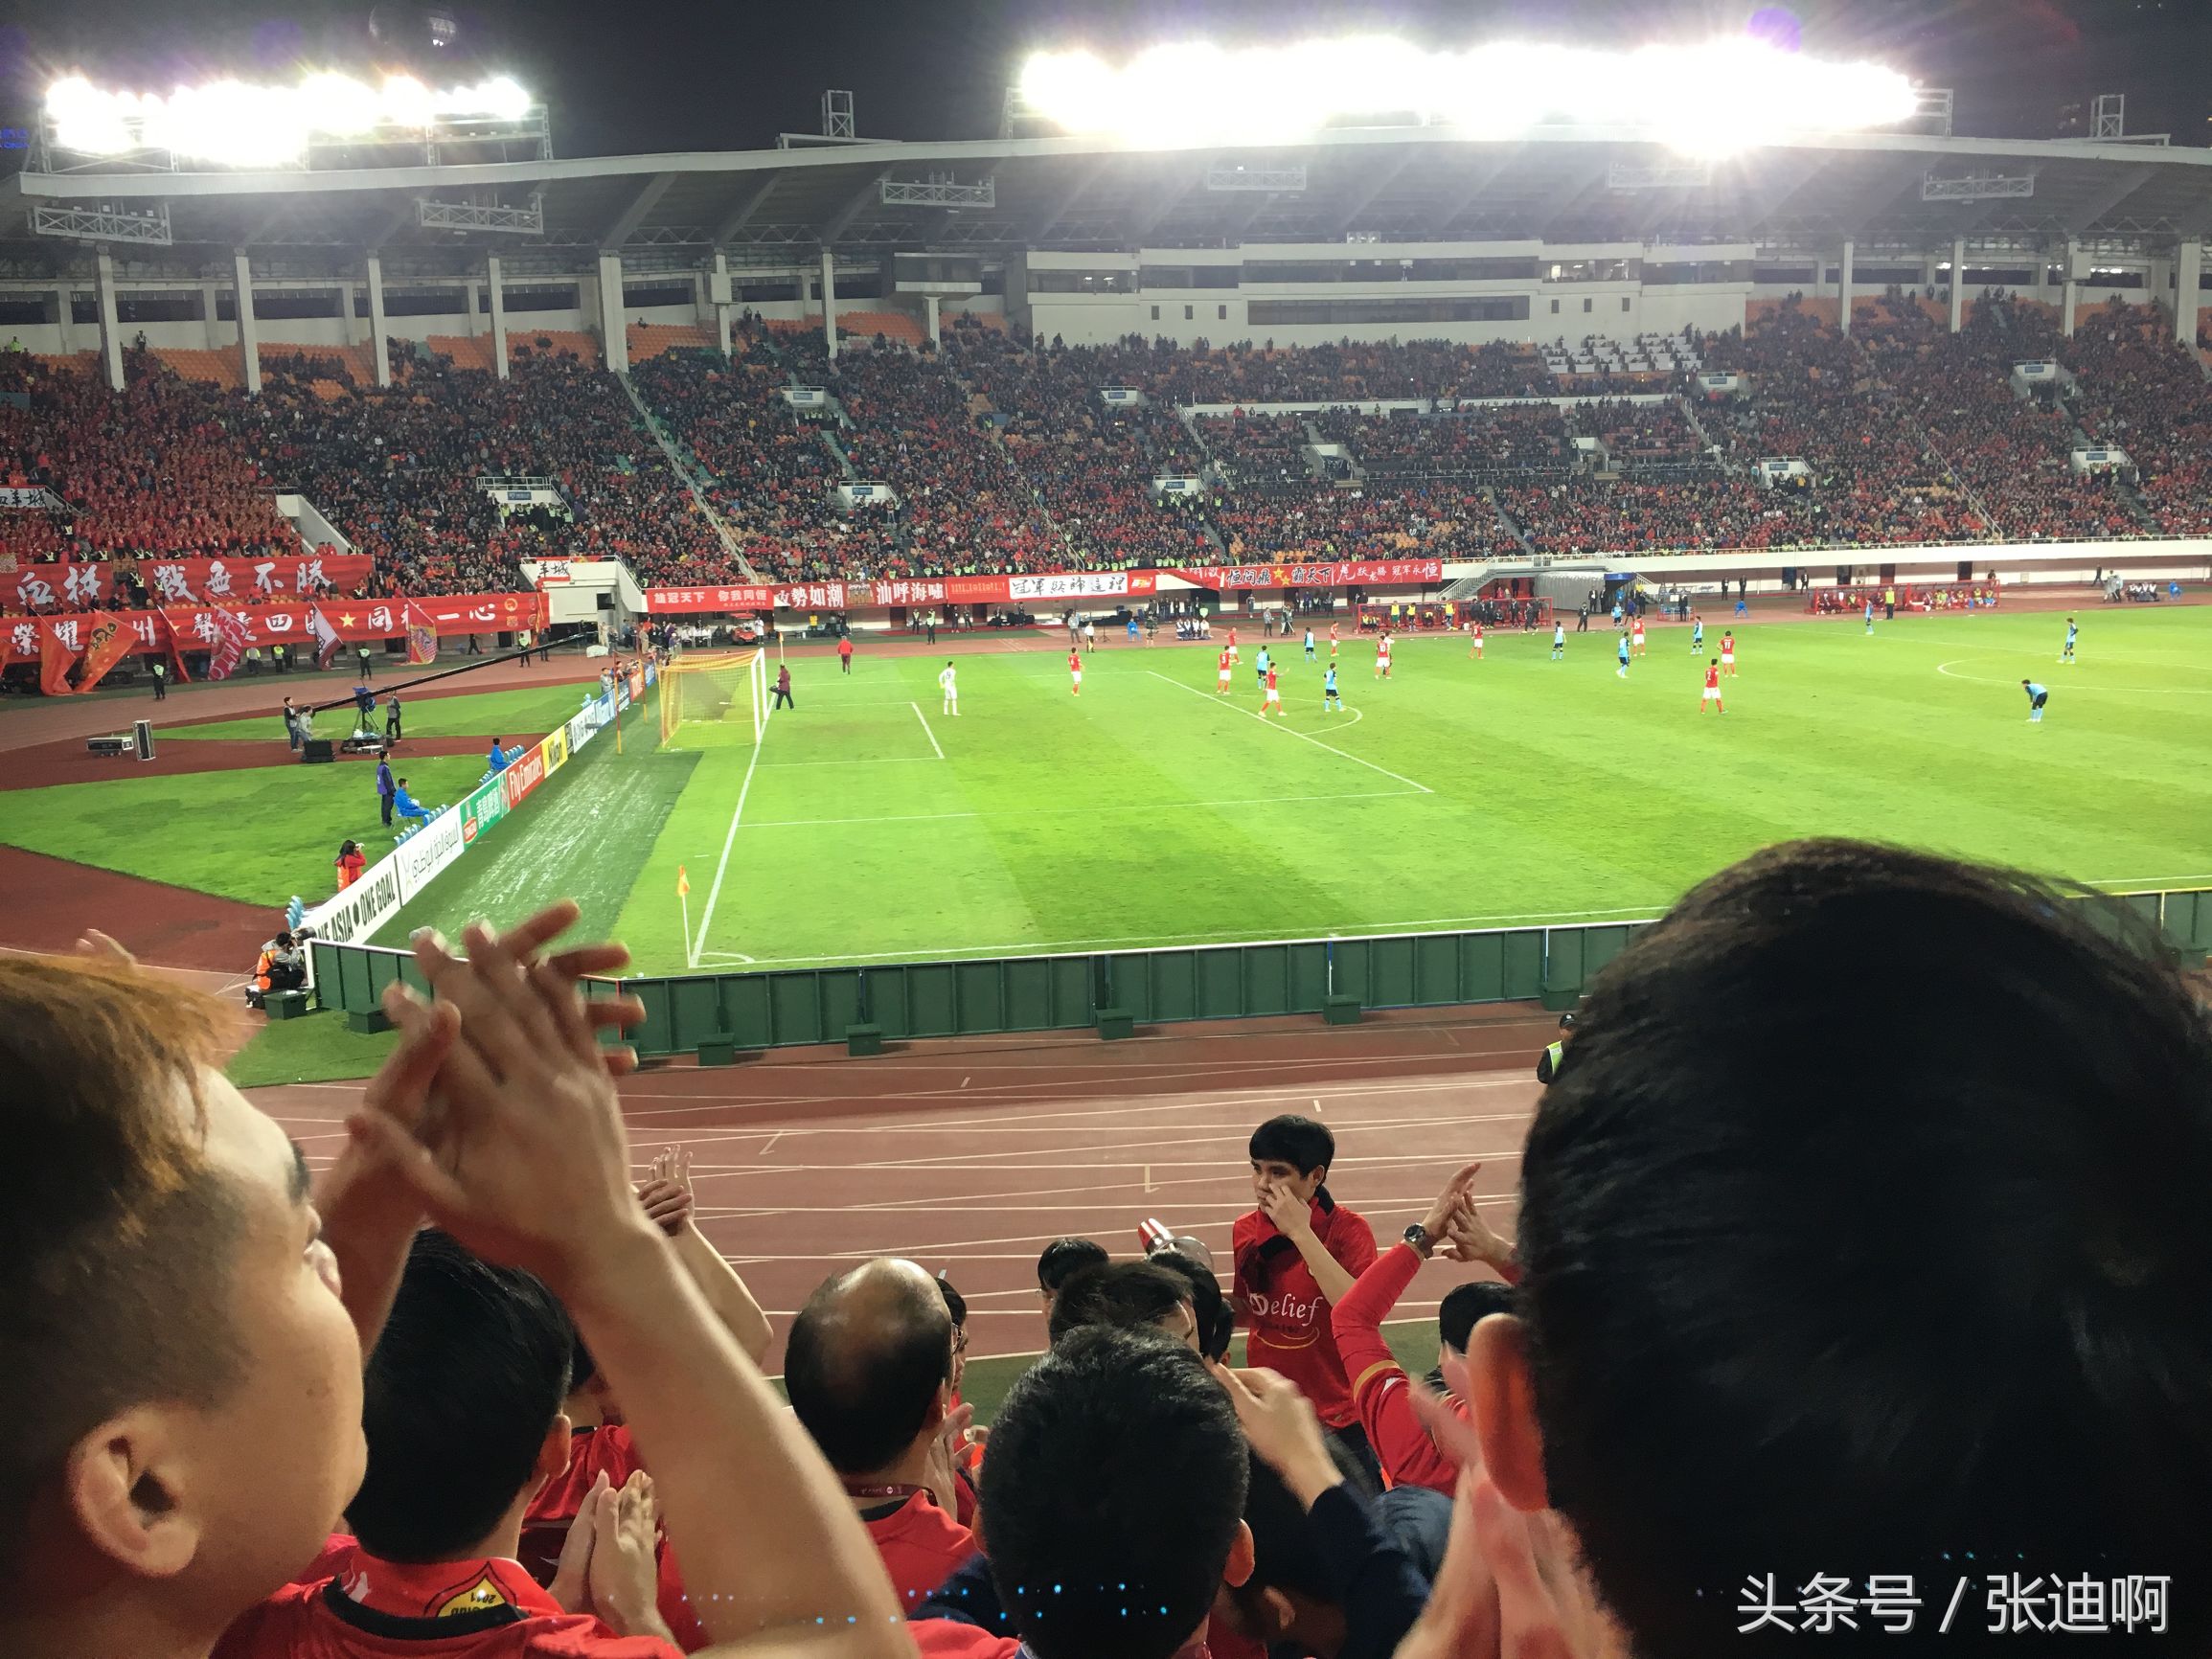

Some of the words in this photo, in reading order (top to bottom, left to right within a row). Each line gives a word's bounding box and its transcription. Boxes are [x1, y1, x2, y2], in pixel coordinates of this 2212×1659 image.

[539, 561, 569, 576] 羊城
[1291, 567, 1332, 584] 霸天下
[360, 886, 376, 926] ONE
[376, 871, 396, 913] GOAL
